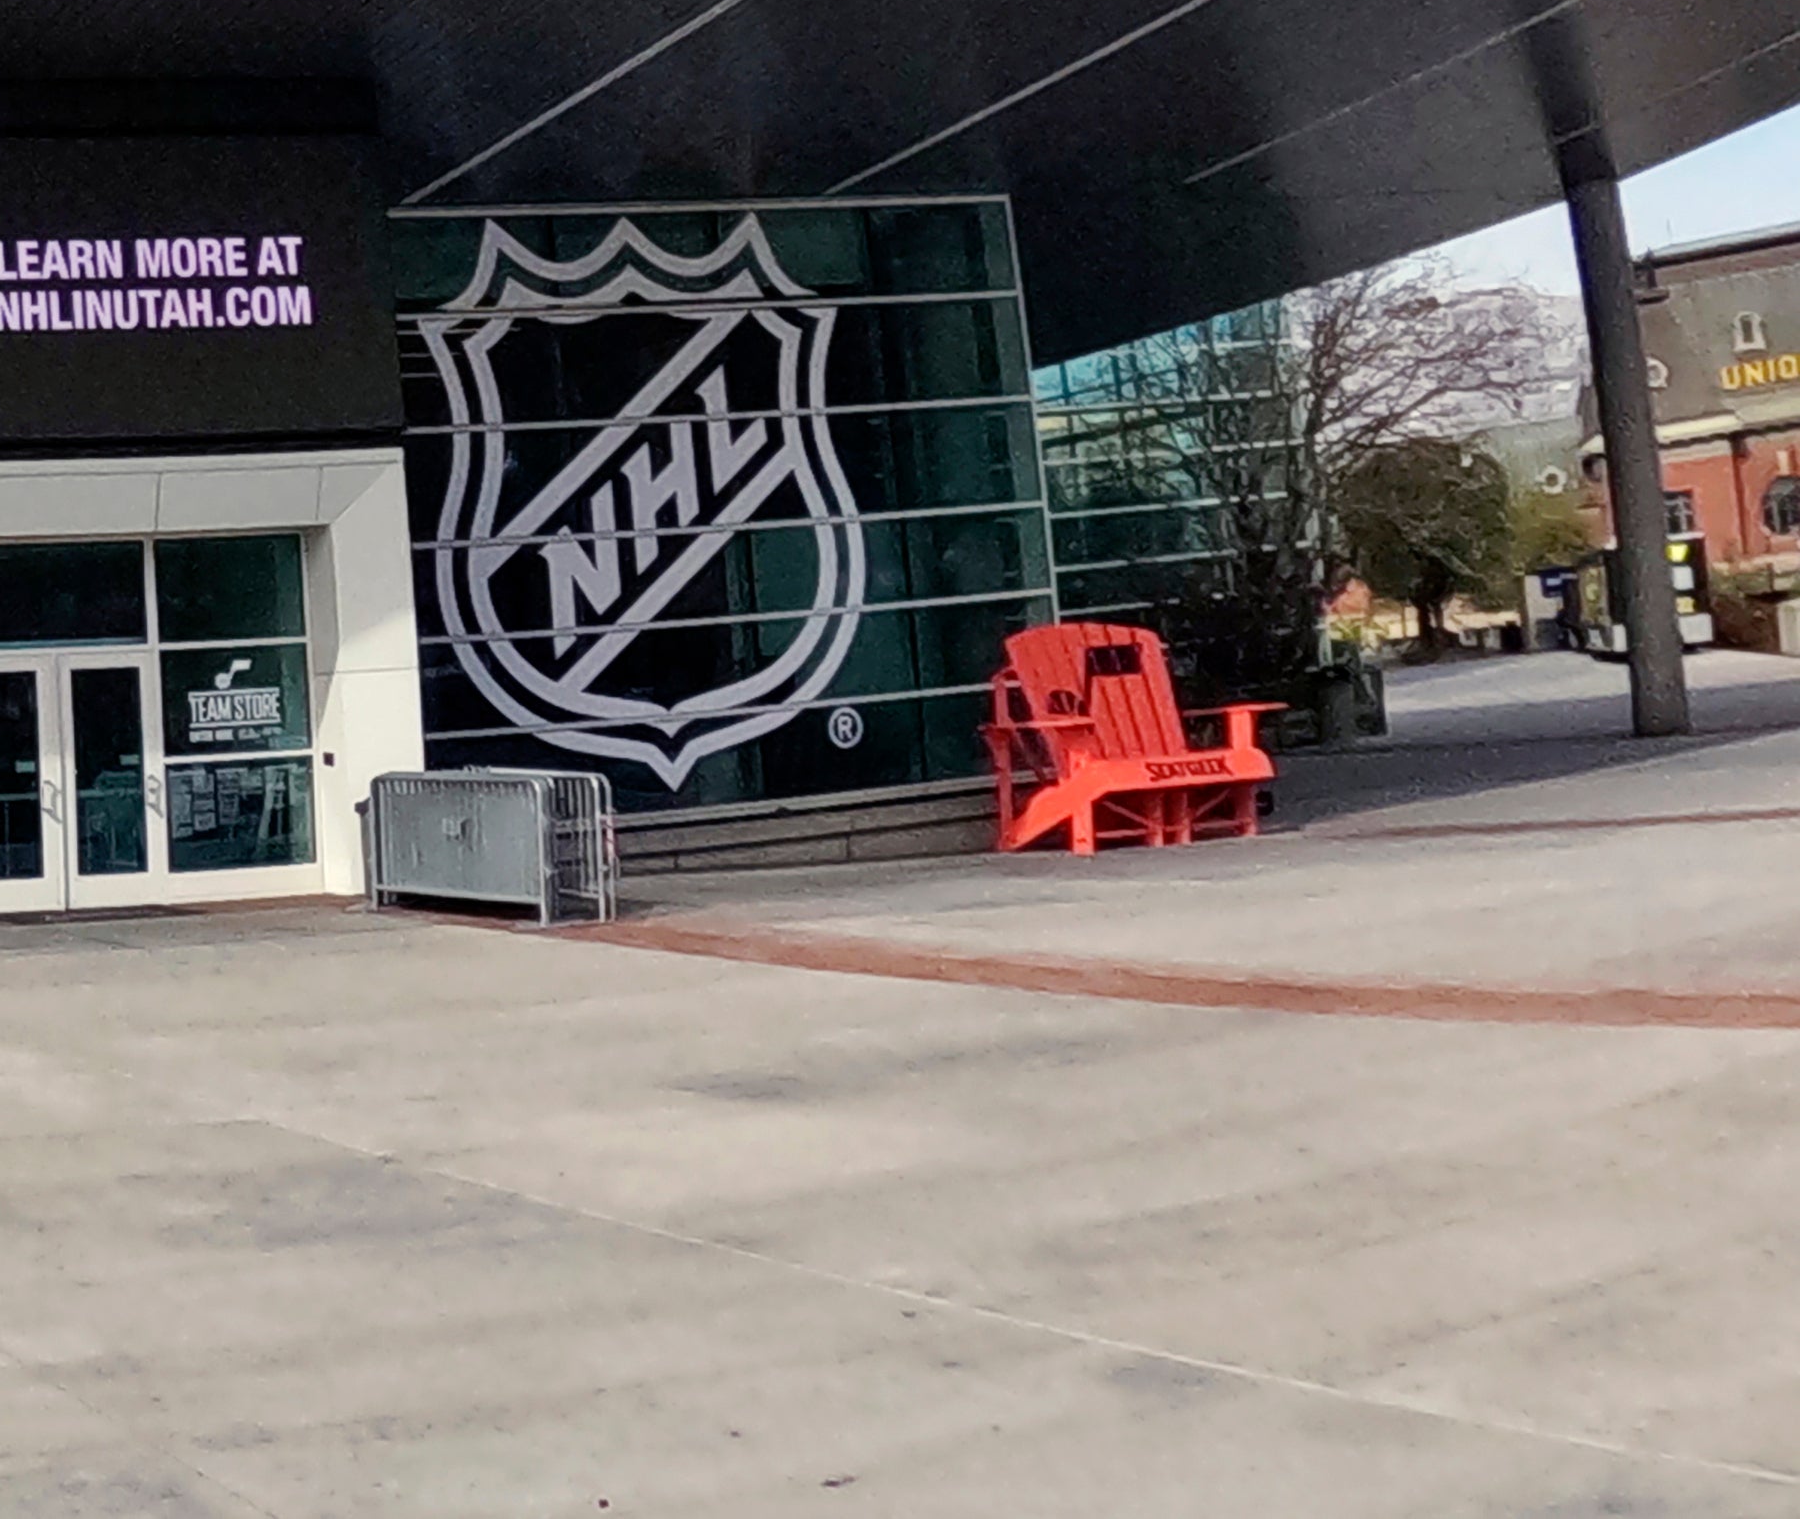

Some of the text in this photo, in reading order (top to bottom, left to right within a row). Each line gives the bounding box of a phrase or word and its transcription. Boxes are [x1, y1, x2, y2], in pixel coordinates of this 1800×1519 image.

[134, 237, 249, 279] MORE
[257, 236, 303, 277] AT
[538, 364, 769, 660] NHL
[188, 692, 281, 724] TEAM STORE
